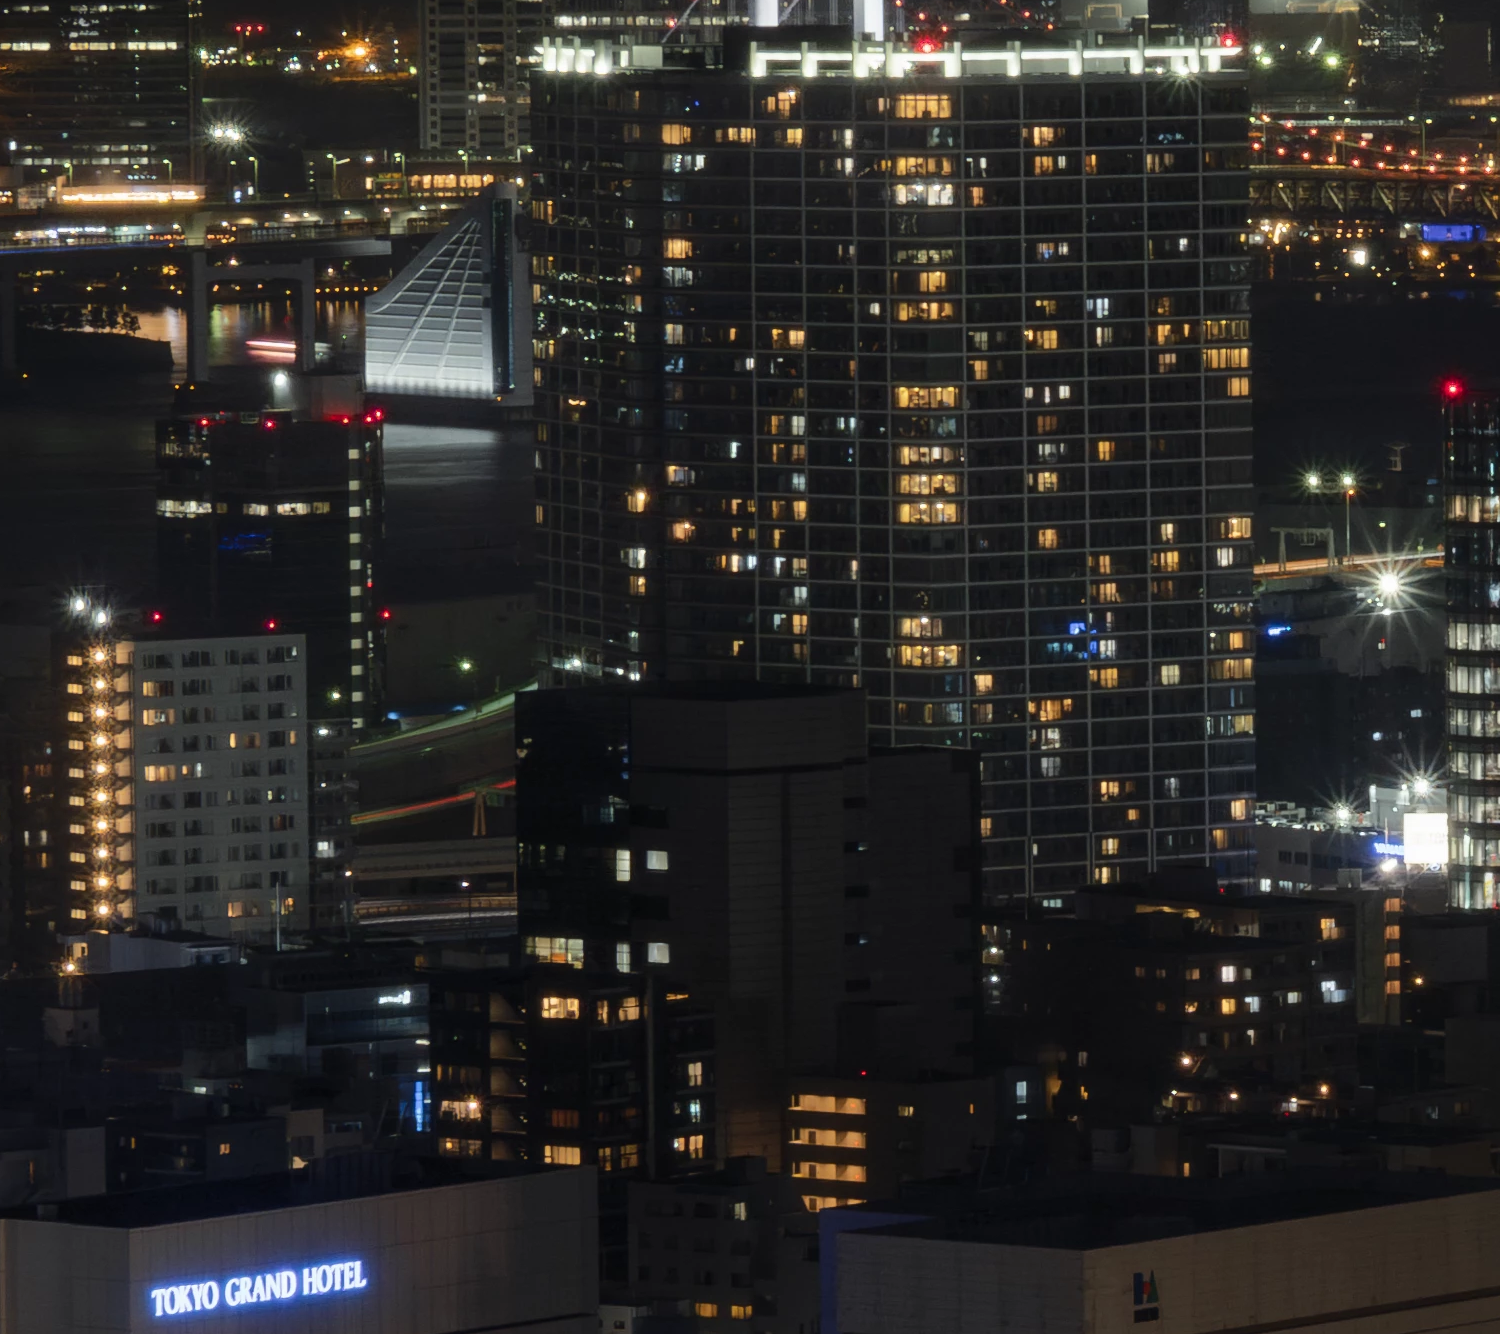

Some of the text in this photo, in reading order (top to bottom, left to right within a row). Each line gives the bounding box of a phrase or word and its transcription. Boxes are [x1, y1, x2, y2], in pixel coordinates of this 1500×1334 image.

[151, 1260, 367, 1317] TOKYO GRAND HOTEL
